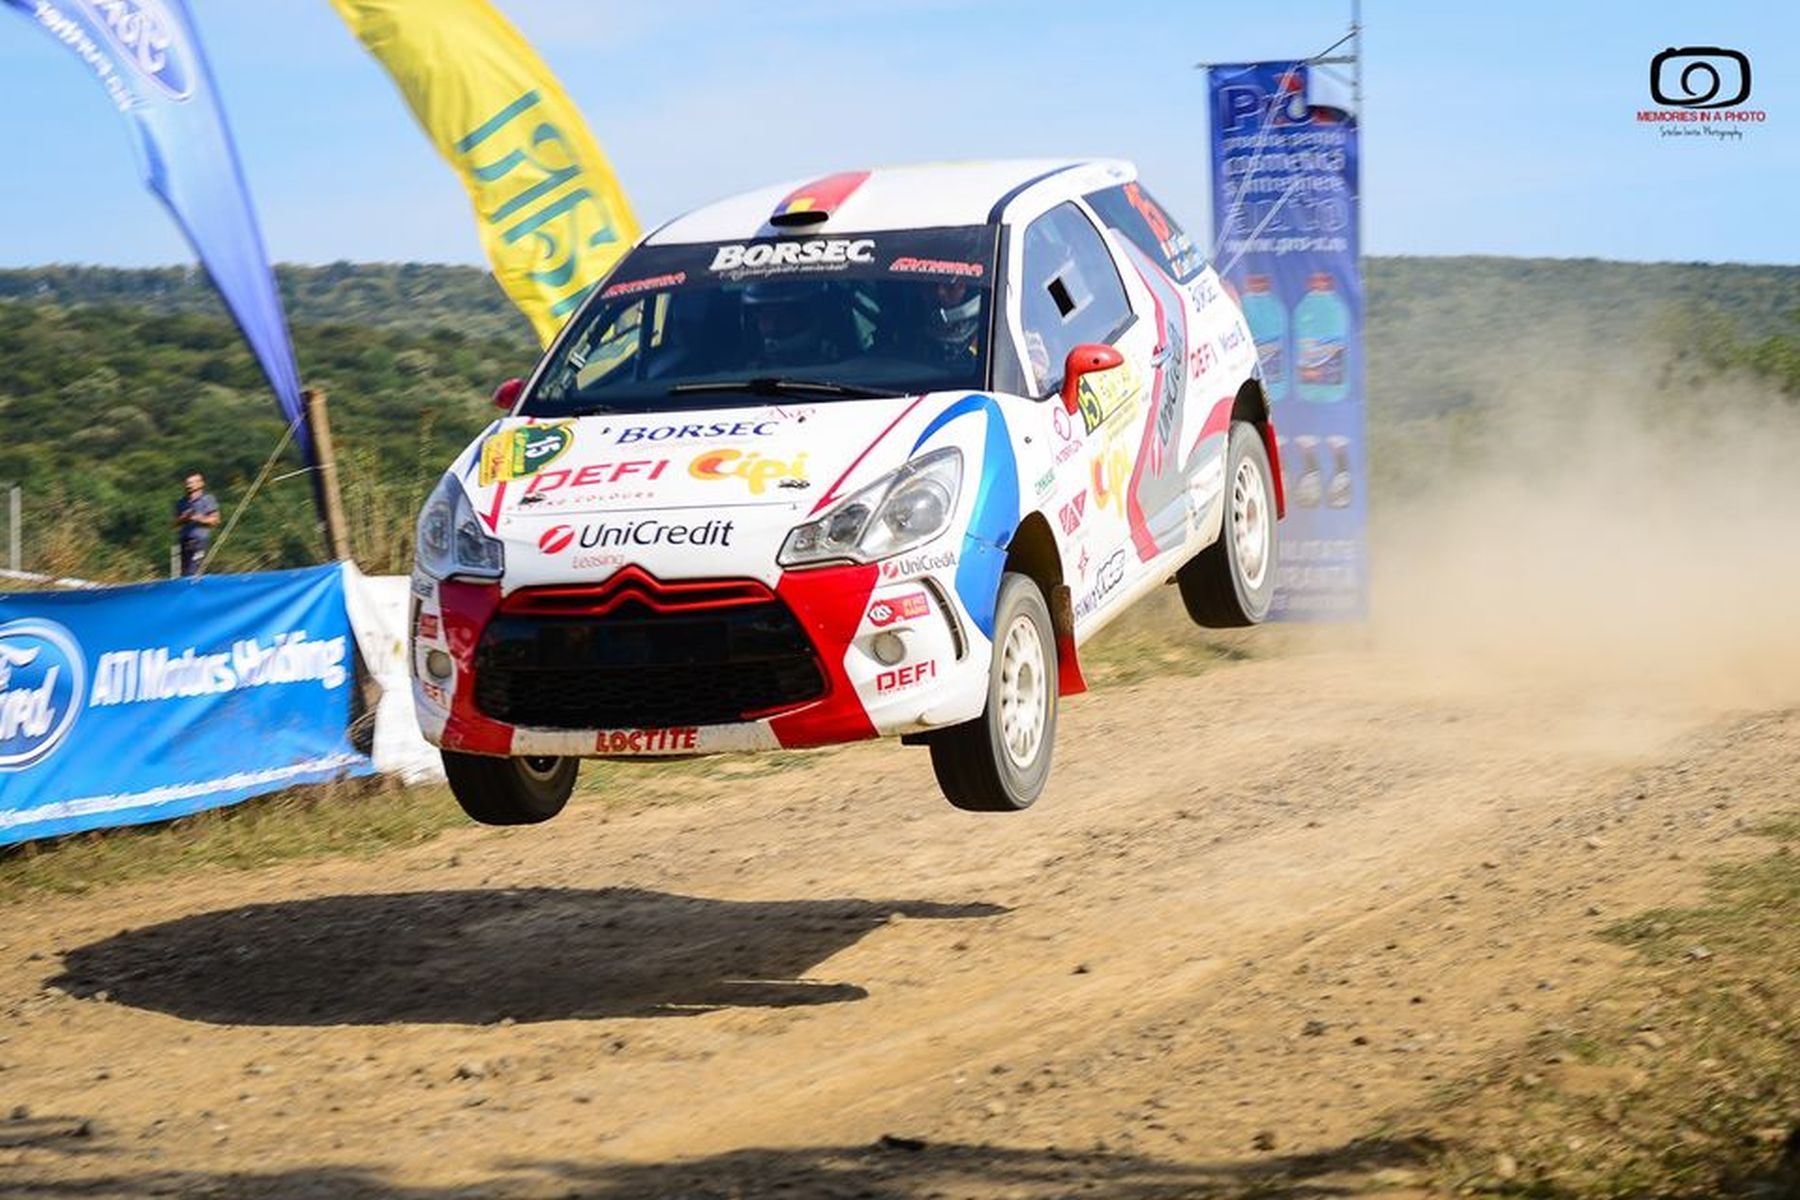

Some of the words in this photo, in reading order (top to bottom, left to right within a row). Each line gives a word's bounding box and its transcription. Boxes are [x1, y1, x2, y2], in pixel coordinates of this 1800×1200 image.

[709, 239, 876, 272] BORSEC
[524, 436, 562, 458] 15
[615, 421, 779, 445] BORSEC
[526, 460, 669, 494] DEFI
[688, 448, 810, 495] Cipi
[579, 520, 733, 548] UniCredit
[900, 551, 956, 575] UniCredit
[138, 647, 237, 702] Motors
[232, 630, 347, 691] Holding
[877, 660, 935, 691] DEFI
[595, 726, 698, 752] LOCTITE
